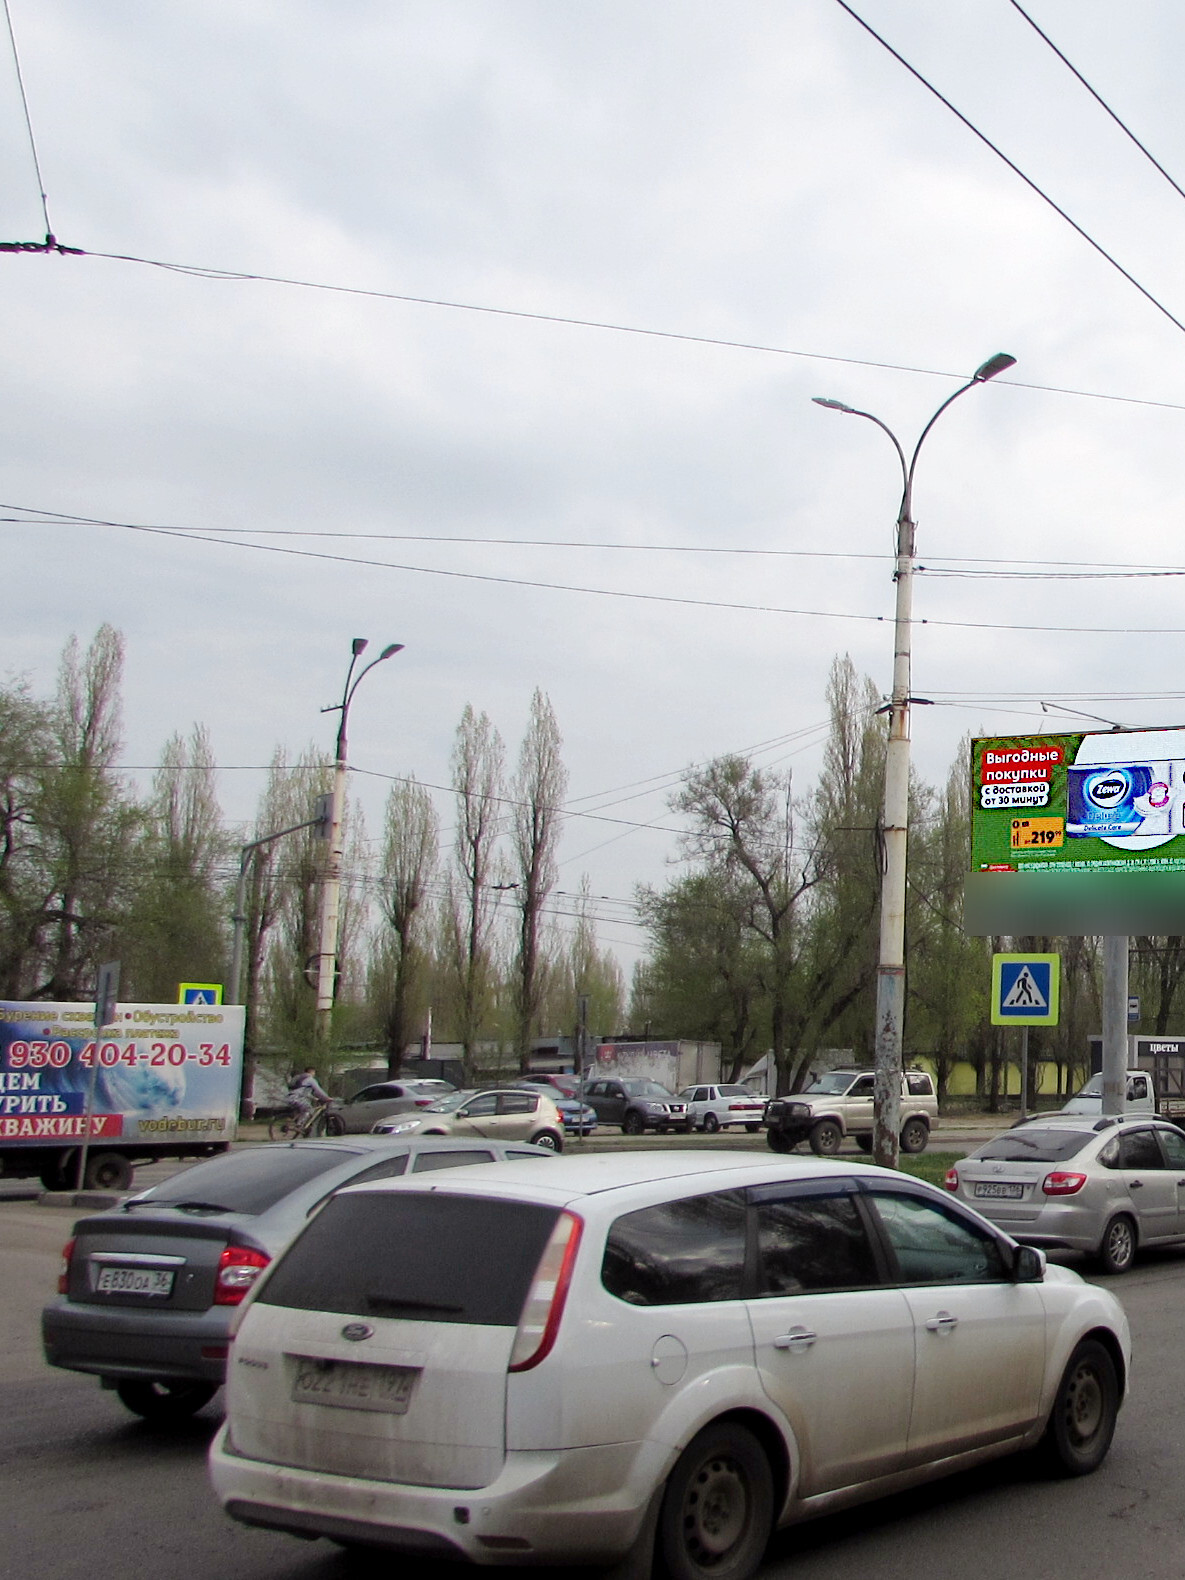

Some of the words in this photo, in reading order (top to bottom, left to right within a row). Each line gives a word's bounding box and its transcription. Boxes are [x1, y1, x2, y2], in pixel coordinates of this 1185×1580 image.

[986, 750, 1059, 764] Выгодные
[986, 769, 1047, 783] покупки
[993, 784, 1046, 794] доставкой
[1095, 784, 1120, 795] Zewa
[999, 796, 1010, 804] 30
[1012, 796, 1044, 805] минут
[1031, 831, 1055, 844] 219
[133, 1010, 224, 1025] Обустройство
[11, 1041, 70, 1067] 930
[80, 1041, 231, 1067] 404-20-34
[0, 1095, 67, 1113] РИТЬ
[0, 1117, 107, 1136] ВАЖИНУ
